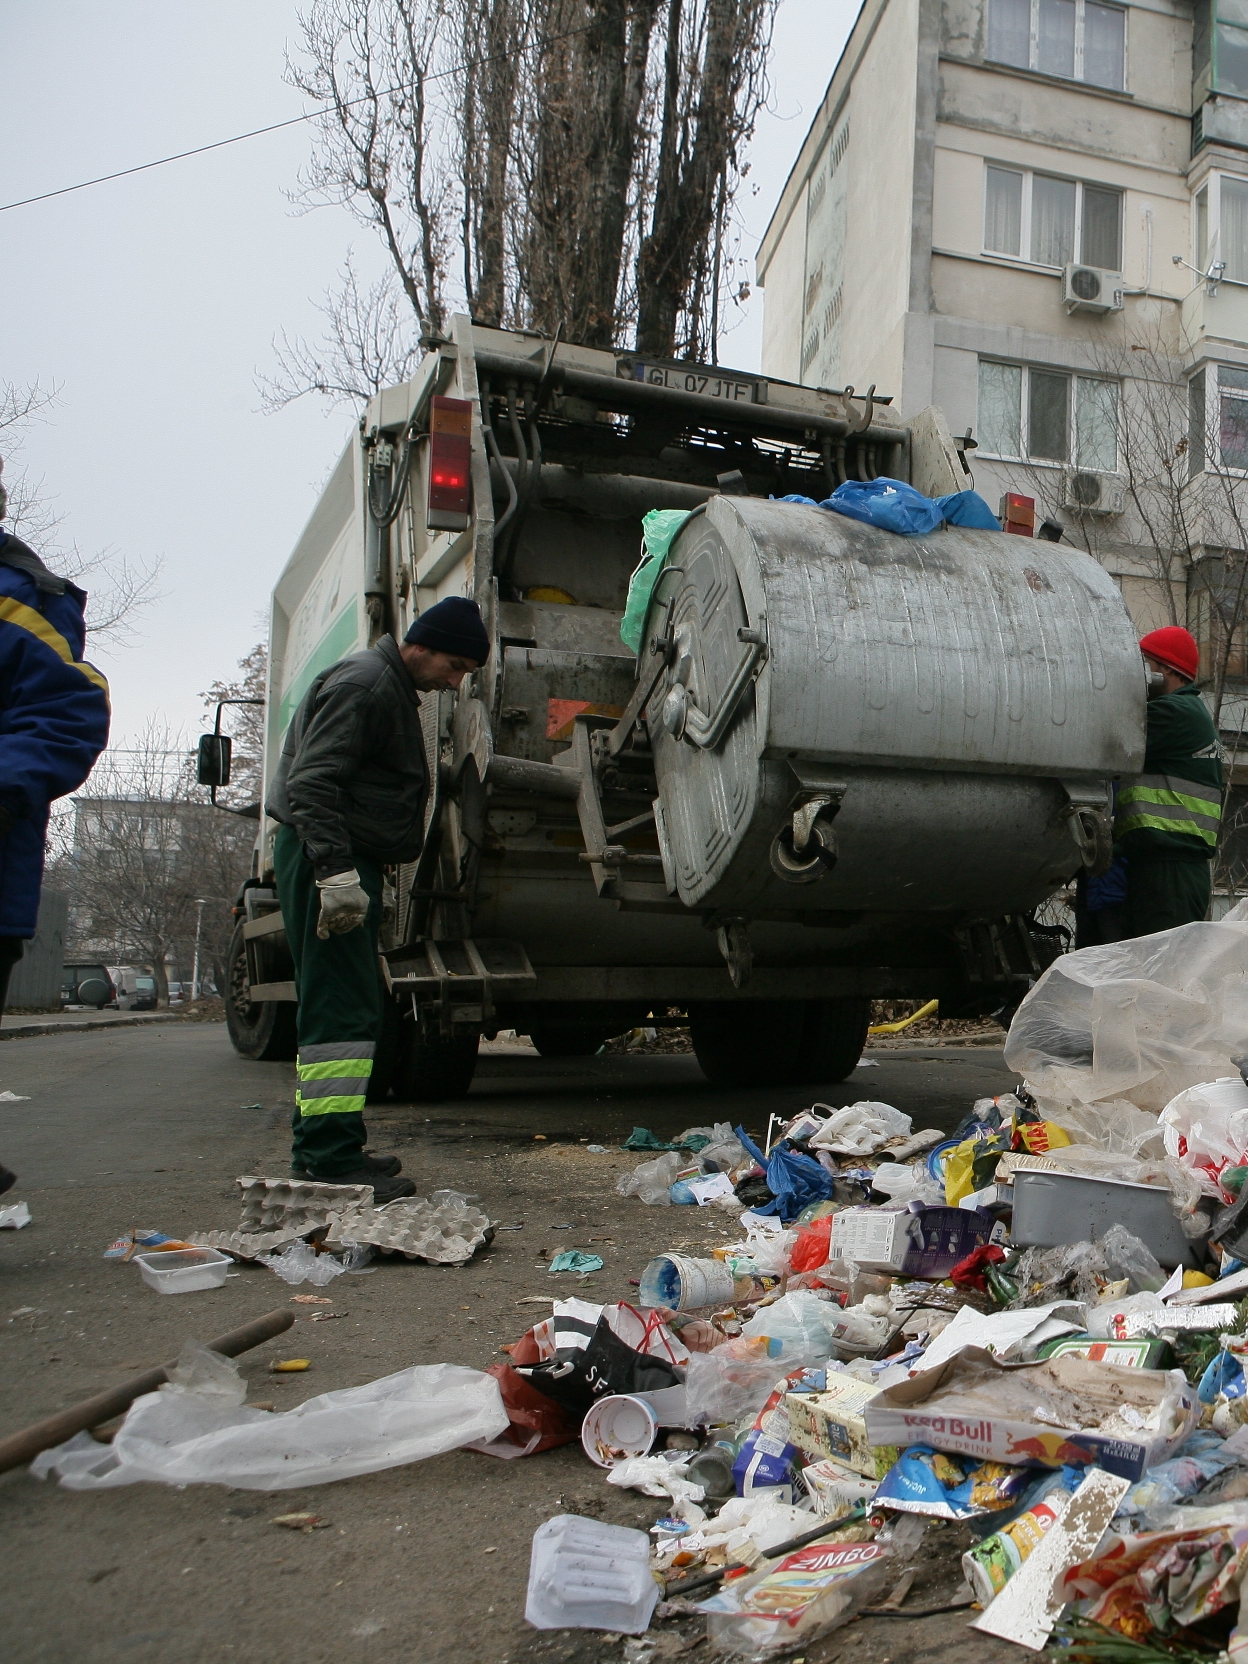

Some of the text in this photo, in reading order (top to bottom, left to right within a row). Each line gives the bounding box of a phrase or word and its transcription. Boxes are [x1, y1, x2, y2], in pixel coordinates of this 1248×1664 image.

[650, 368, 749, 401] GL 07 JTF
[950, 1418, 992, 1443] Bull
[954, 1440, 993, 1456] DRINK
[789, 1544, 879, 1572] ZIMBO
